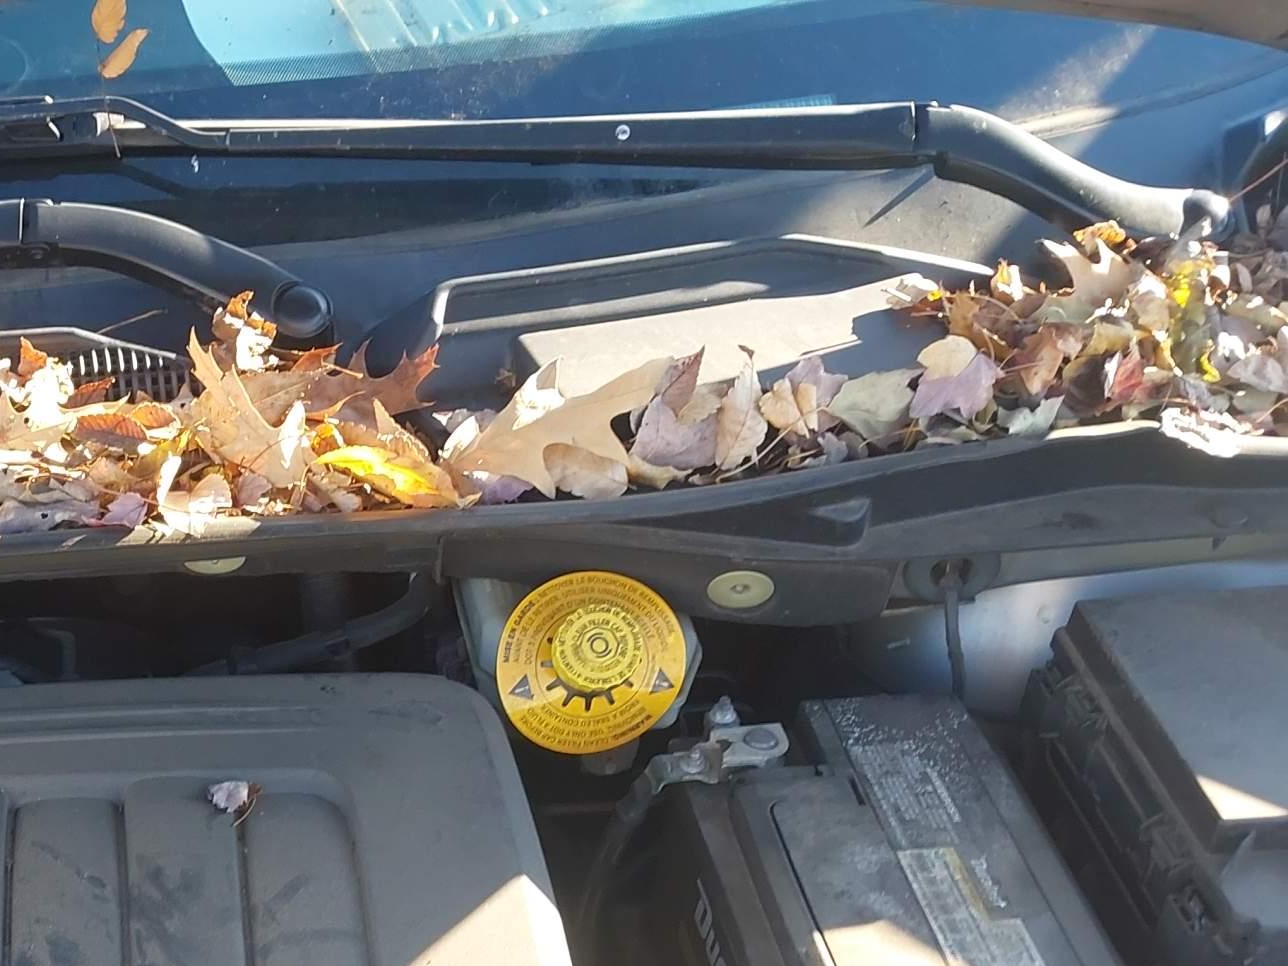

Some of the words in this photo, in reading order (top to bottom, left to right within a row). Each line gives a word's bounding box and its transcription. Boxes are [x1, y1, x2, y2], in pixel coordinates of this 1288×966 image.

[503, 642, 511, 662] MISE
[507, 626, 516, 639] EN
[512, 599, 534, 626] GARDE
